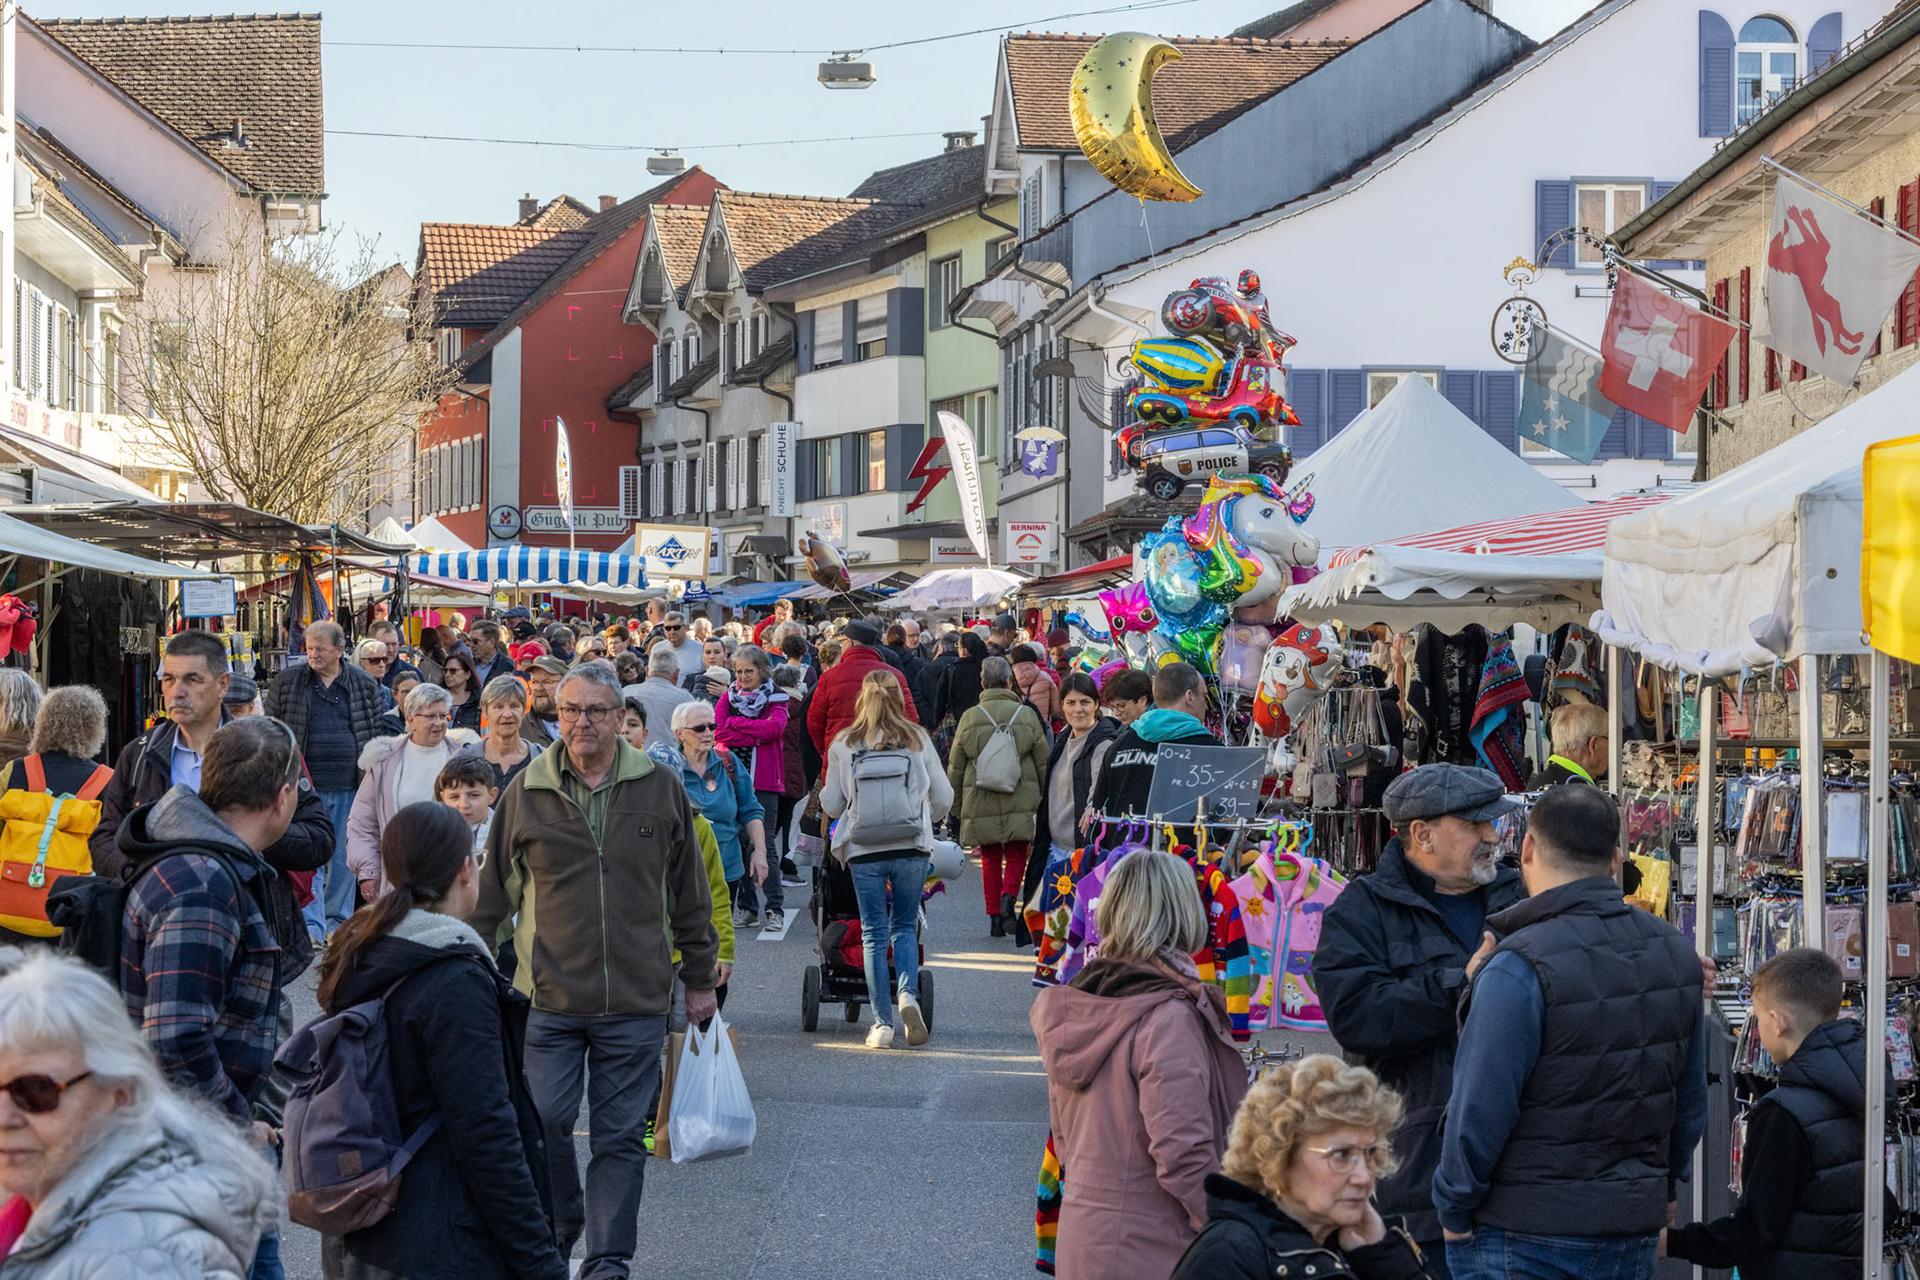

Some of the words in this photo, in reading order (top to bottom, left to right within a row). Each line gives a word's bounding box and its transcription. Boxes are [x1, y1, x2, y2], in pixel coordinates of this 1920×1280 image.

[778, 424, 787, 473] SCHUHE
[1197, 456, 1238, 471] POLICE
[591, 512, 623, 529] Pub
[642, 545, 702, 560] MARTIN
[938, 545, 956, 553] Kanal
[957, 545, 972, 553] total
